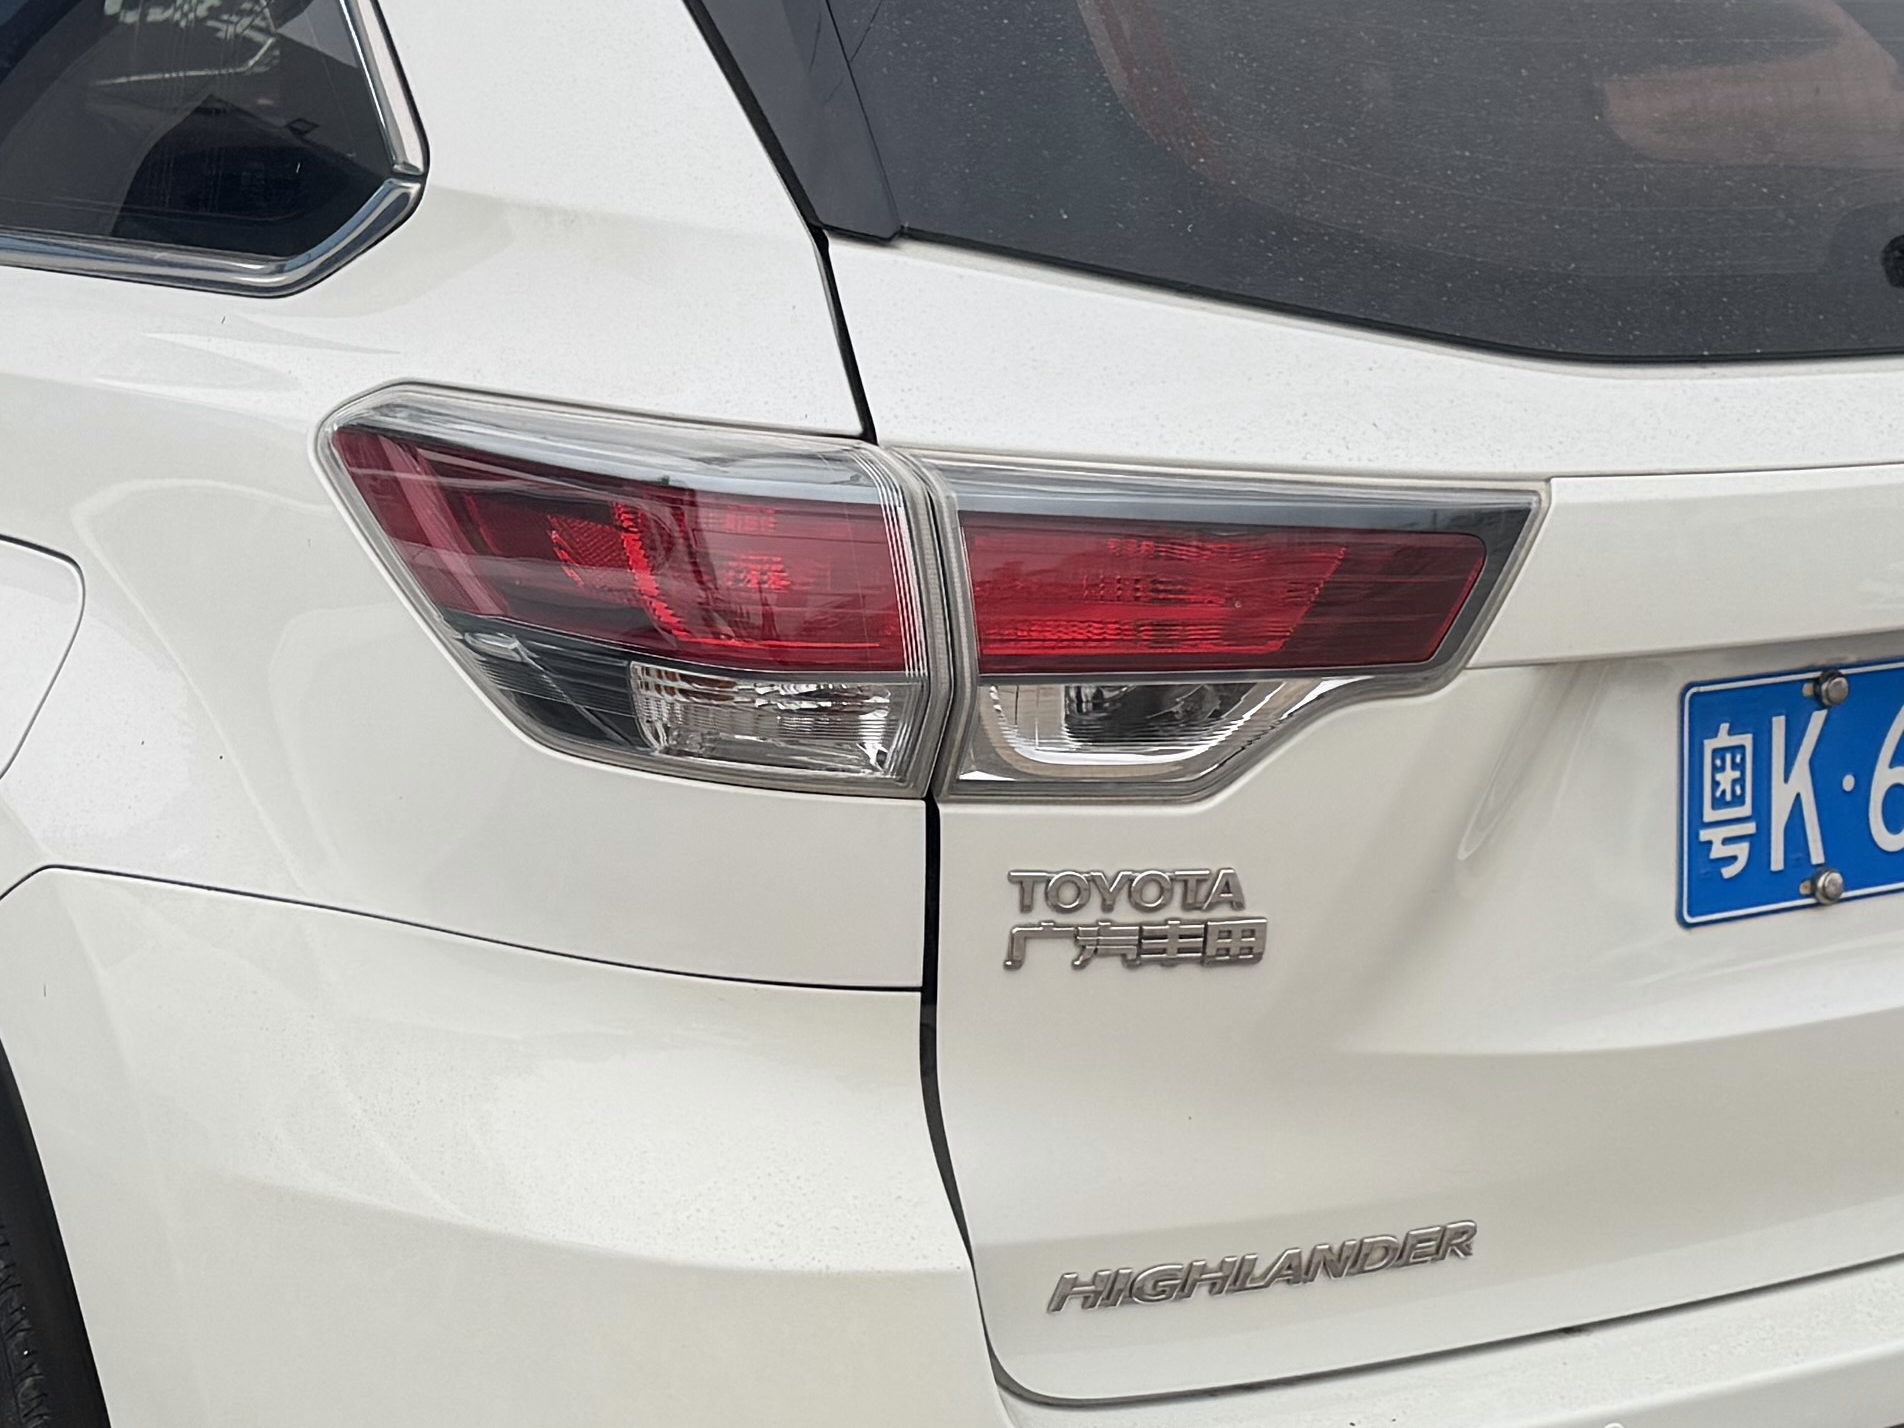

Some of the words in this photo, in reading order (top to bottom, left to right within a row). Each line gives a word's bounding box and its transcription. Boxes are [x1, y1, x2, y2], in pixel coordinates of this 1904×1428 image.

[1007, 867, 1246, 913] TOYOTA
[1002, 917, 1268, 970] 广汽丰田
[1046, 1219, 1478, 1314] HIGHLANDER
